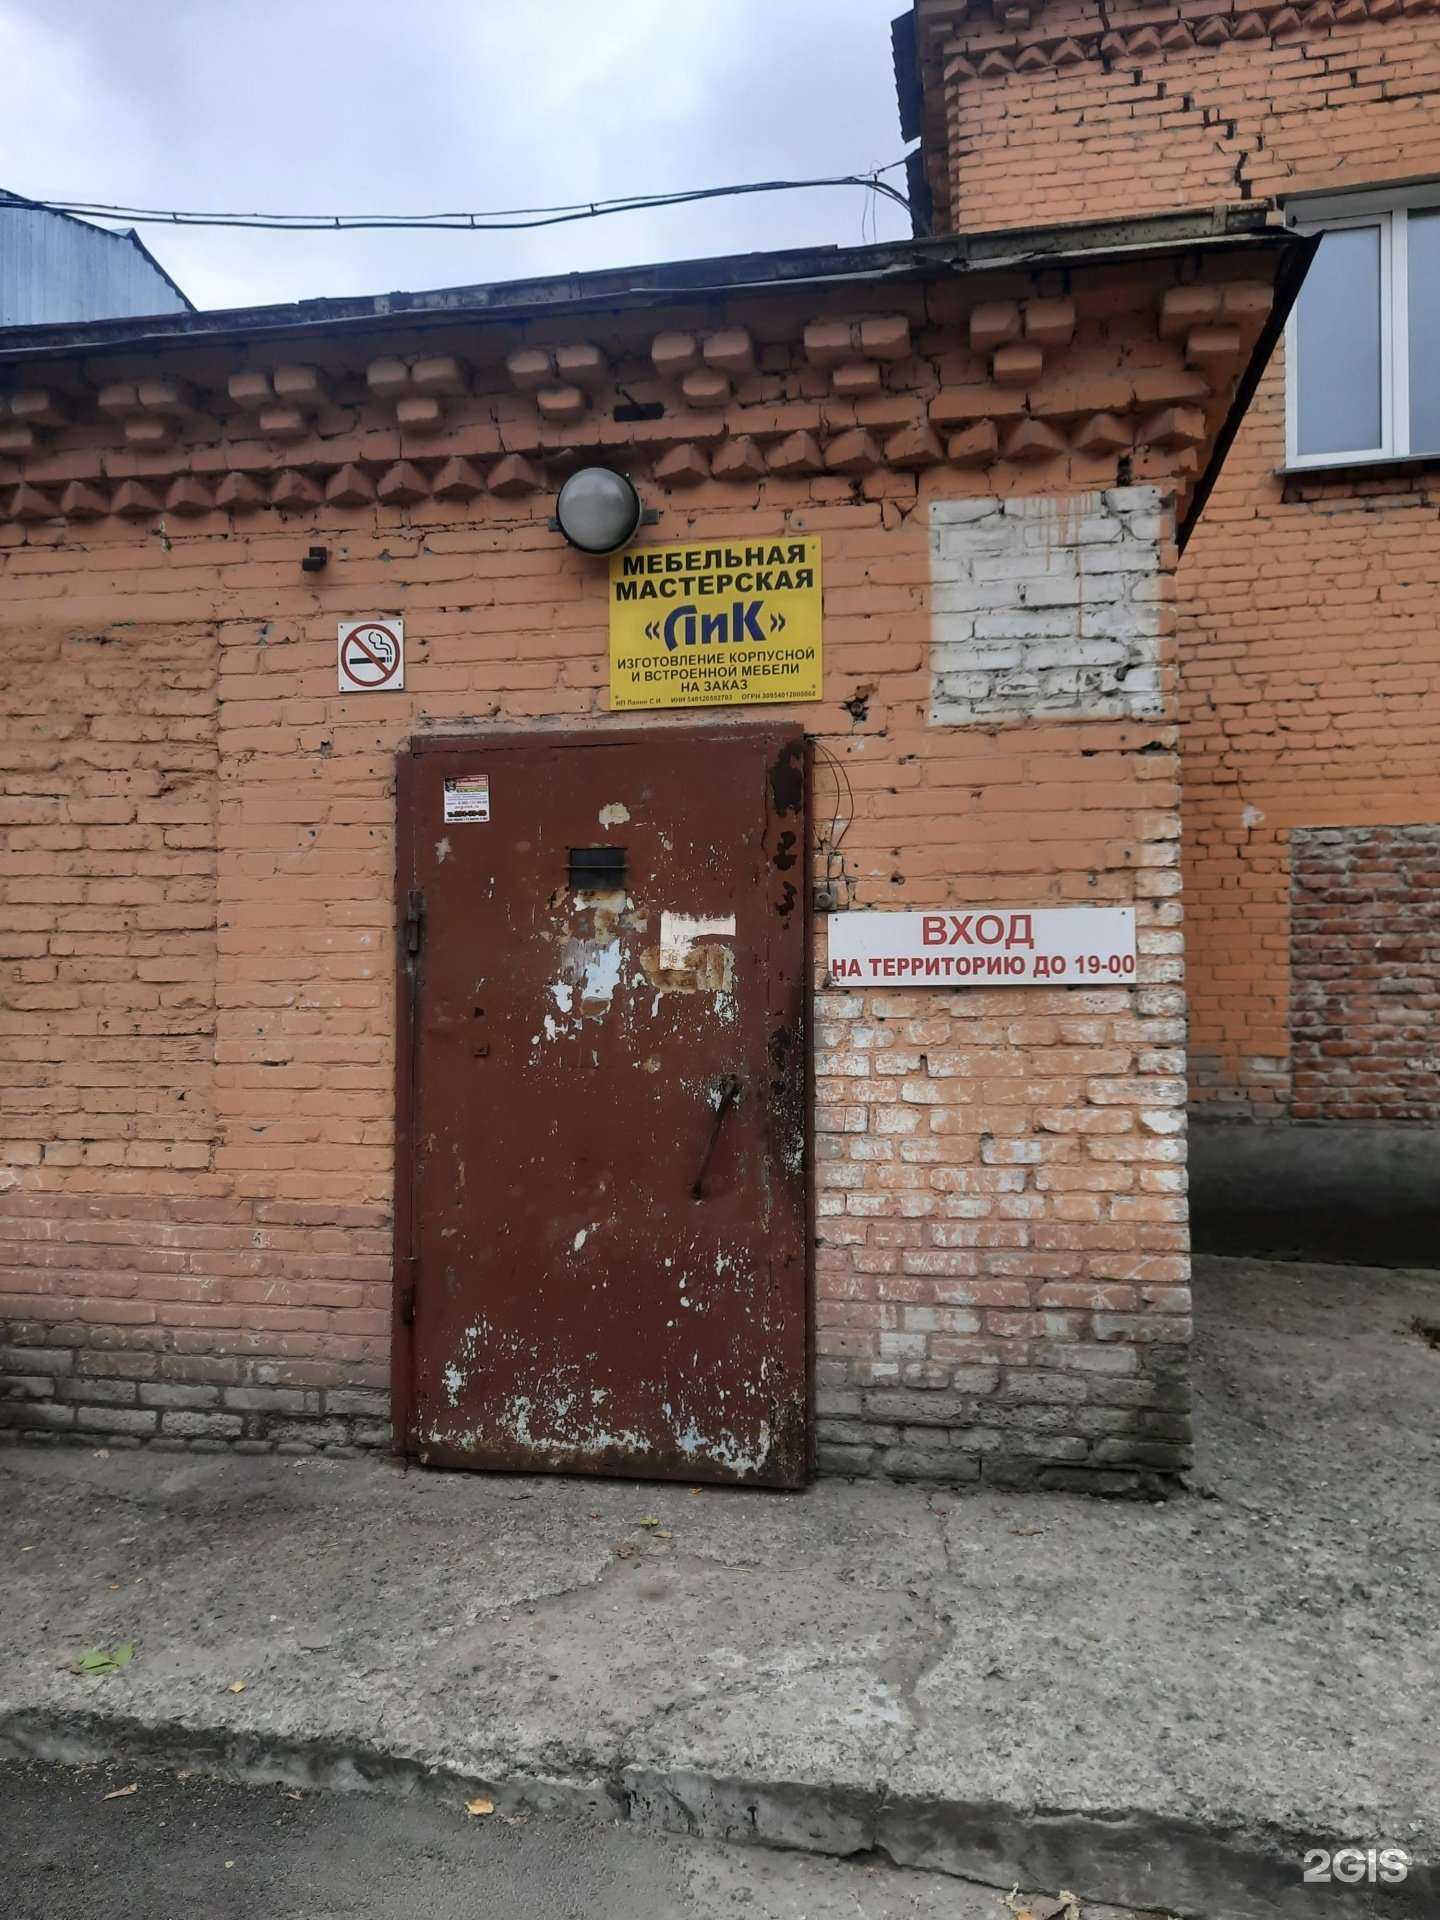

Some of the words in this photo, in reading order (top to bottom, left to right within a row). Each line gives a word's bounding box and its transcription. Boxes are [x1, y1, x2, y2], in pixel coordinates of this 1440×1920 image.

[623, 544, 806, 577] МЕБЕЛЬНАЯ
[616, 568, 814, 601] МАСТЕРСКАЯ
[617, 652, 724, 670] ИЗГОТОВЛЕНИЕ
[729, 647, 815, 663] КОРПУСНОЙ
[631, 672, 640, 682] И
[644, 667, 737, 682] ВСТРОЕННОЙ
[741, 663, 800, 677] МЕБЕЛИ
[681, 682, 700, 693] НА
[704, 679, 748, 692] ЗАКАЗ
[922, 914, 1035, 950] ВХОД
[832, 958, 862, 977] НА
[868, 956, 1026, 977] ТЕРРИТОРИЮ
[1032, 955, 1067, 978] ДО
[1075, 954, 1135, 975] 19-00
